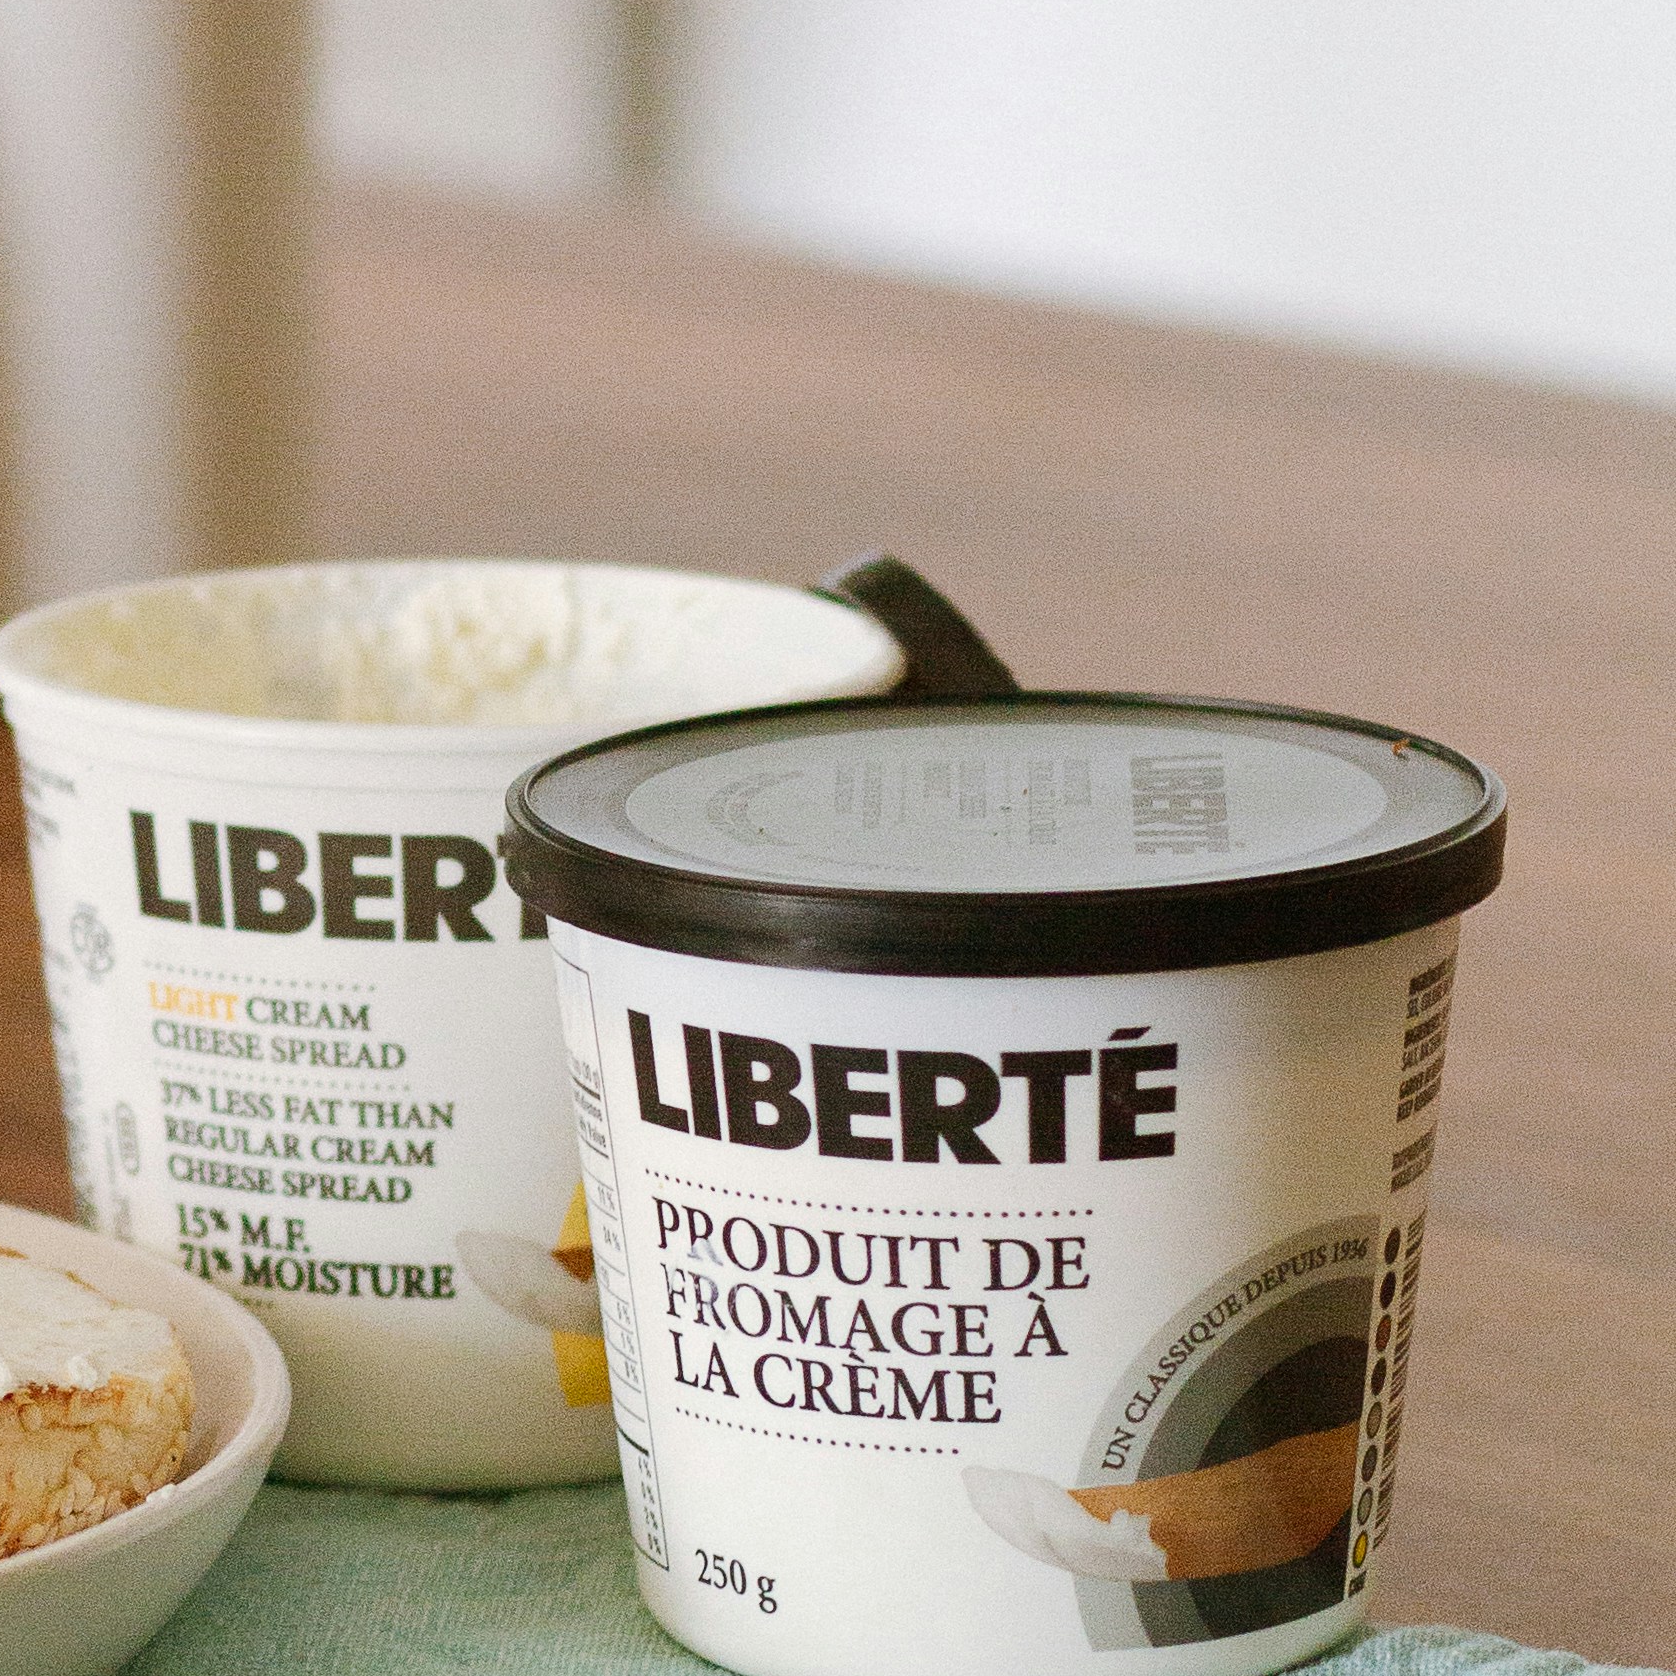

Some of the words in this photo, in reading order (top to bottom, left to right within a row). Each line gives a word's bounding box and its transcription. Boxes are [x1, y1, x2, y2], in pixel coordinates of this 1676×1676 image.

[129, 808, 549, 942] LIBER
[149, 981, 239, 1022] LIGHT
[246, 995, 372, 1031] CREAM
[153, 1019, 263, 1062] CHEESE
[271, 1036, 407, 1070] SPREAD
[209, 1085, 274, 1120] LESS
[282, 1094, 343, 1126] FAT
[349, 1098, 455, 1129] THAN
[627, 1008, 1178, 1165] LIBERTÉ
[165, 1114, 303, 1160] REGULAR
[311, 1135, 436, 1167] CREAM
[168, 1153, 275, 1194] CHEESE
[281, 1170, 413, 1203] SPREAD
[240, 1211, 312, 1253] M.F.
[652, 1195, 959, 1291] PRODUIT
[982, 1235, 1090, 1292] DE
[242, 1251, 457, 1300] MOISTURE
[660, 1262, 994, 1358] FROMAGE
[1014, 1291, 1068, 1358] À
[670, 1329, 740, 1399] LA
[753, 1352, 1002, 1424] CRÈME
[1102, 1426, 1136, 1471] UN
[1124, 1294, 1243, 1425] CLASSIQUE
[1241, 1246, 1327, 1304] DEPUIS
[695, 1548, 747, 1596] 250
[756, 1575, 778, 1614] g
